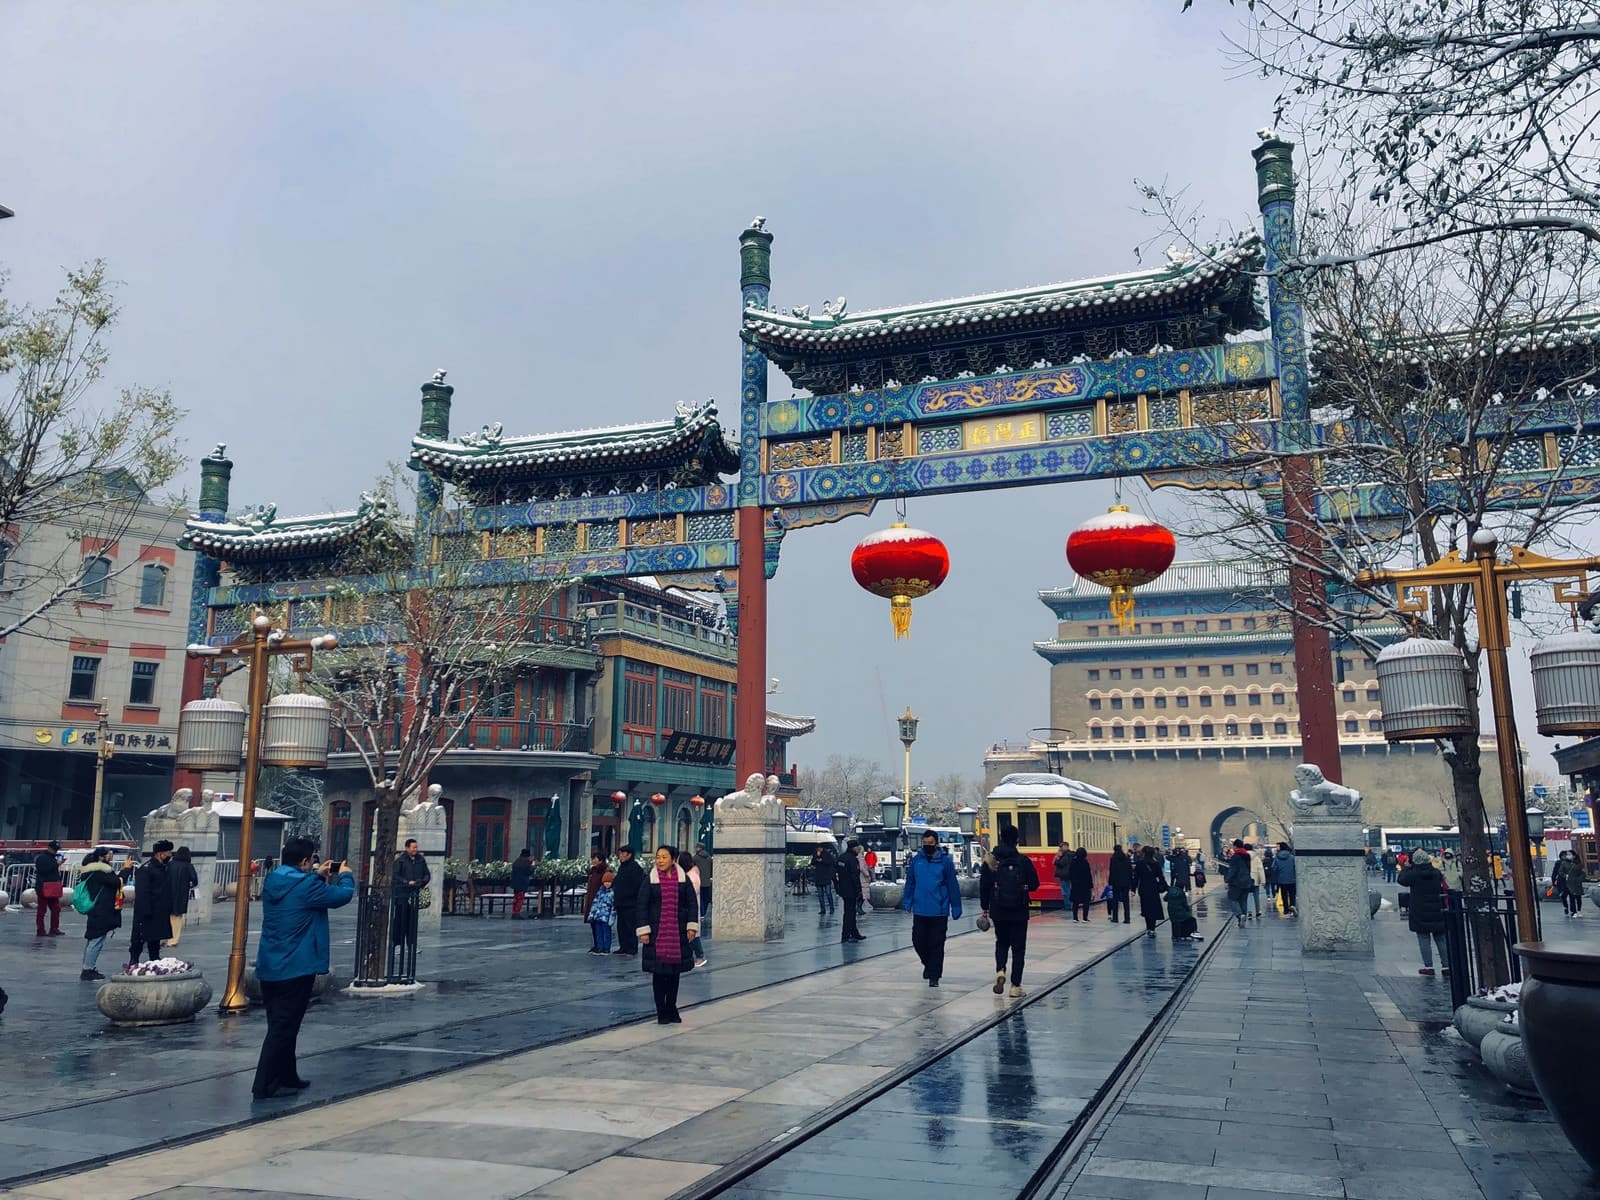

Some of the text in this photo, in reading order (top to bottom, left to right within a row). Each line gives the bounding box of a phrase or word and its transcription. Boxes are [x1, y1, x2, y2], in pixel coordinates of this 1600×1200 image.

[673, 736, 731, 759] 星巴克咖啡
